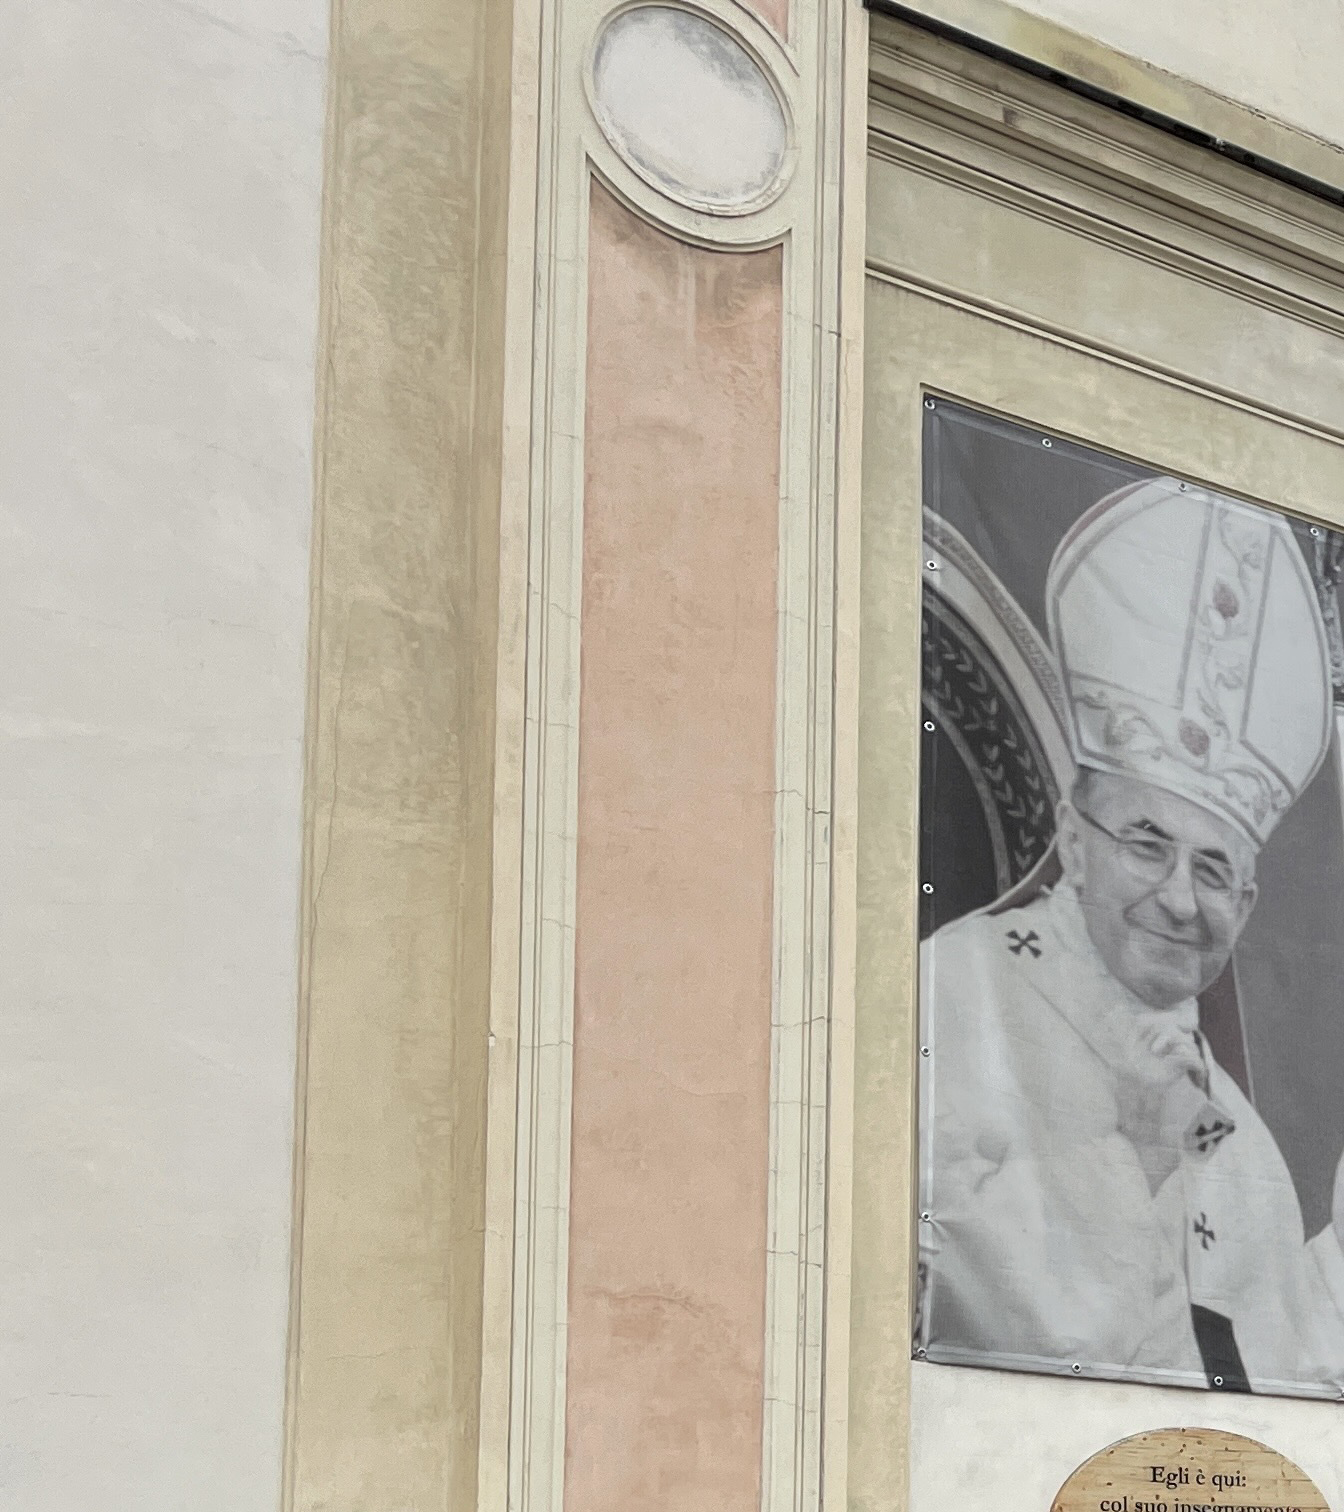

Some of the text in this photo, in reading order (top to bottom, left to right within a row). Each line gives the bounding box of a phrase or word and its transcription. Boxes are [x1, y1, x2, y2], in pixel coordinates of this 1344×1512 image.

[1150, 1466, 1247, 1492] Egli è qui:
[1100, 1496, 1128, 1512] col
